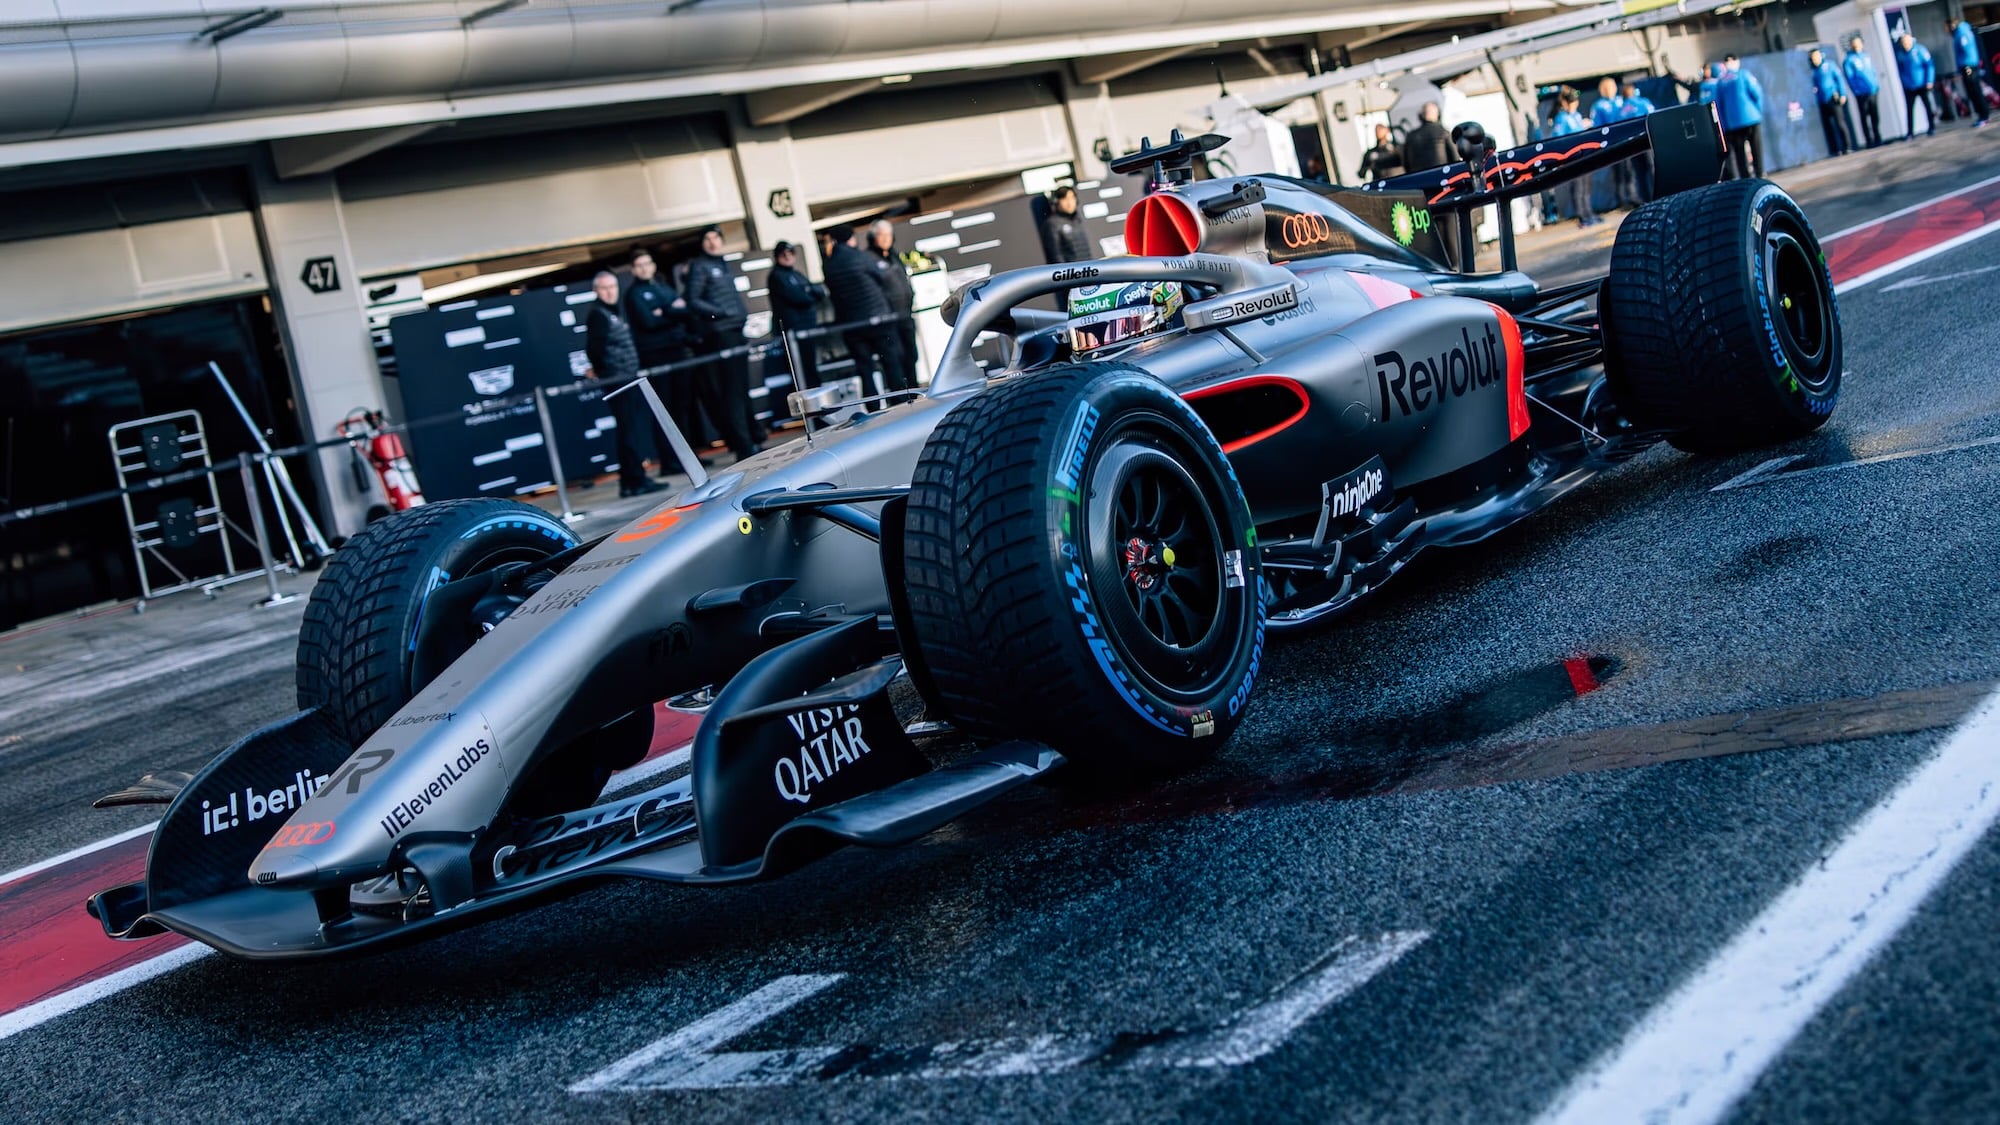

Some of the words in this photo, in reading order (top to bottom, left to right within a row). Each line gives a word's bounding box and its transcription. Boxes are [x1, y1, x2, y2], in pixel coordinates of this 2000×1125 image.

[1412, 205, 1431, 234] bp
[309, 262, 334, 288] 47
[1052, 267, 1099, 281] Gillette
[1161, 260, 1195, 270] WORLD
[1197, 260, 1207, 271] OF
[1208, 261, 1232, 273] HYATT
[1073, 298, 1111, 316] Revolut
[1234, 290, 1293, 316] Revolut
[1374, 322, 1500, 423] Revolut
[1055, 400, 1100, 492] PIRELLI
[1333, 468, 1383, 518] ninjaOne
[775, 717, 871, 803] QATAR
